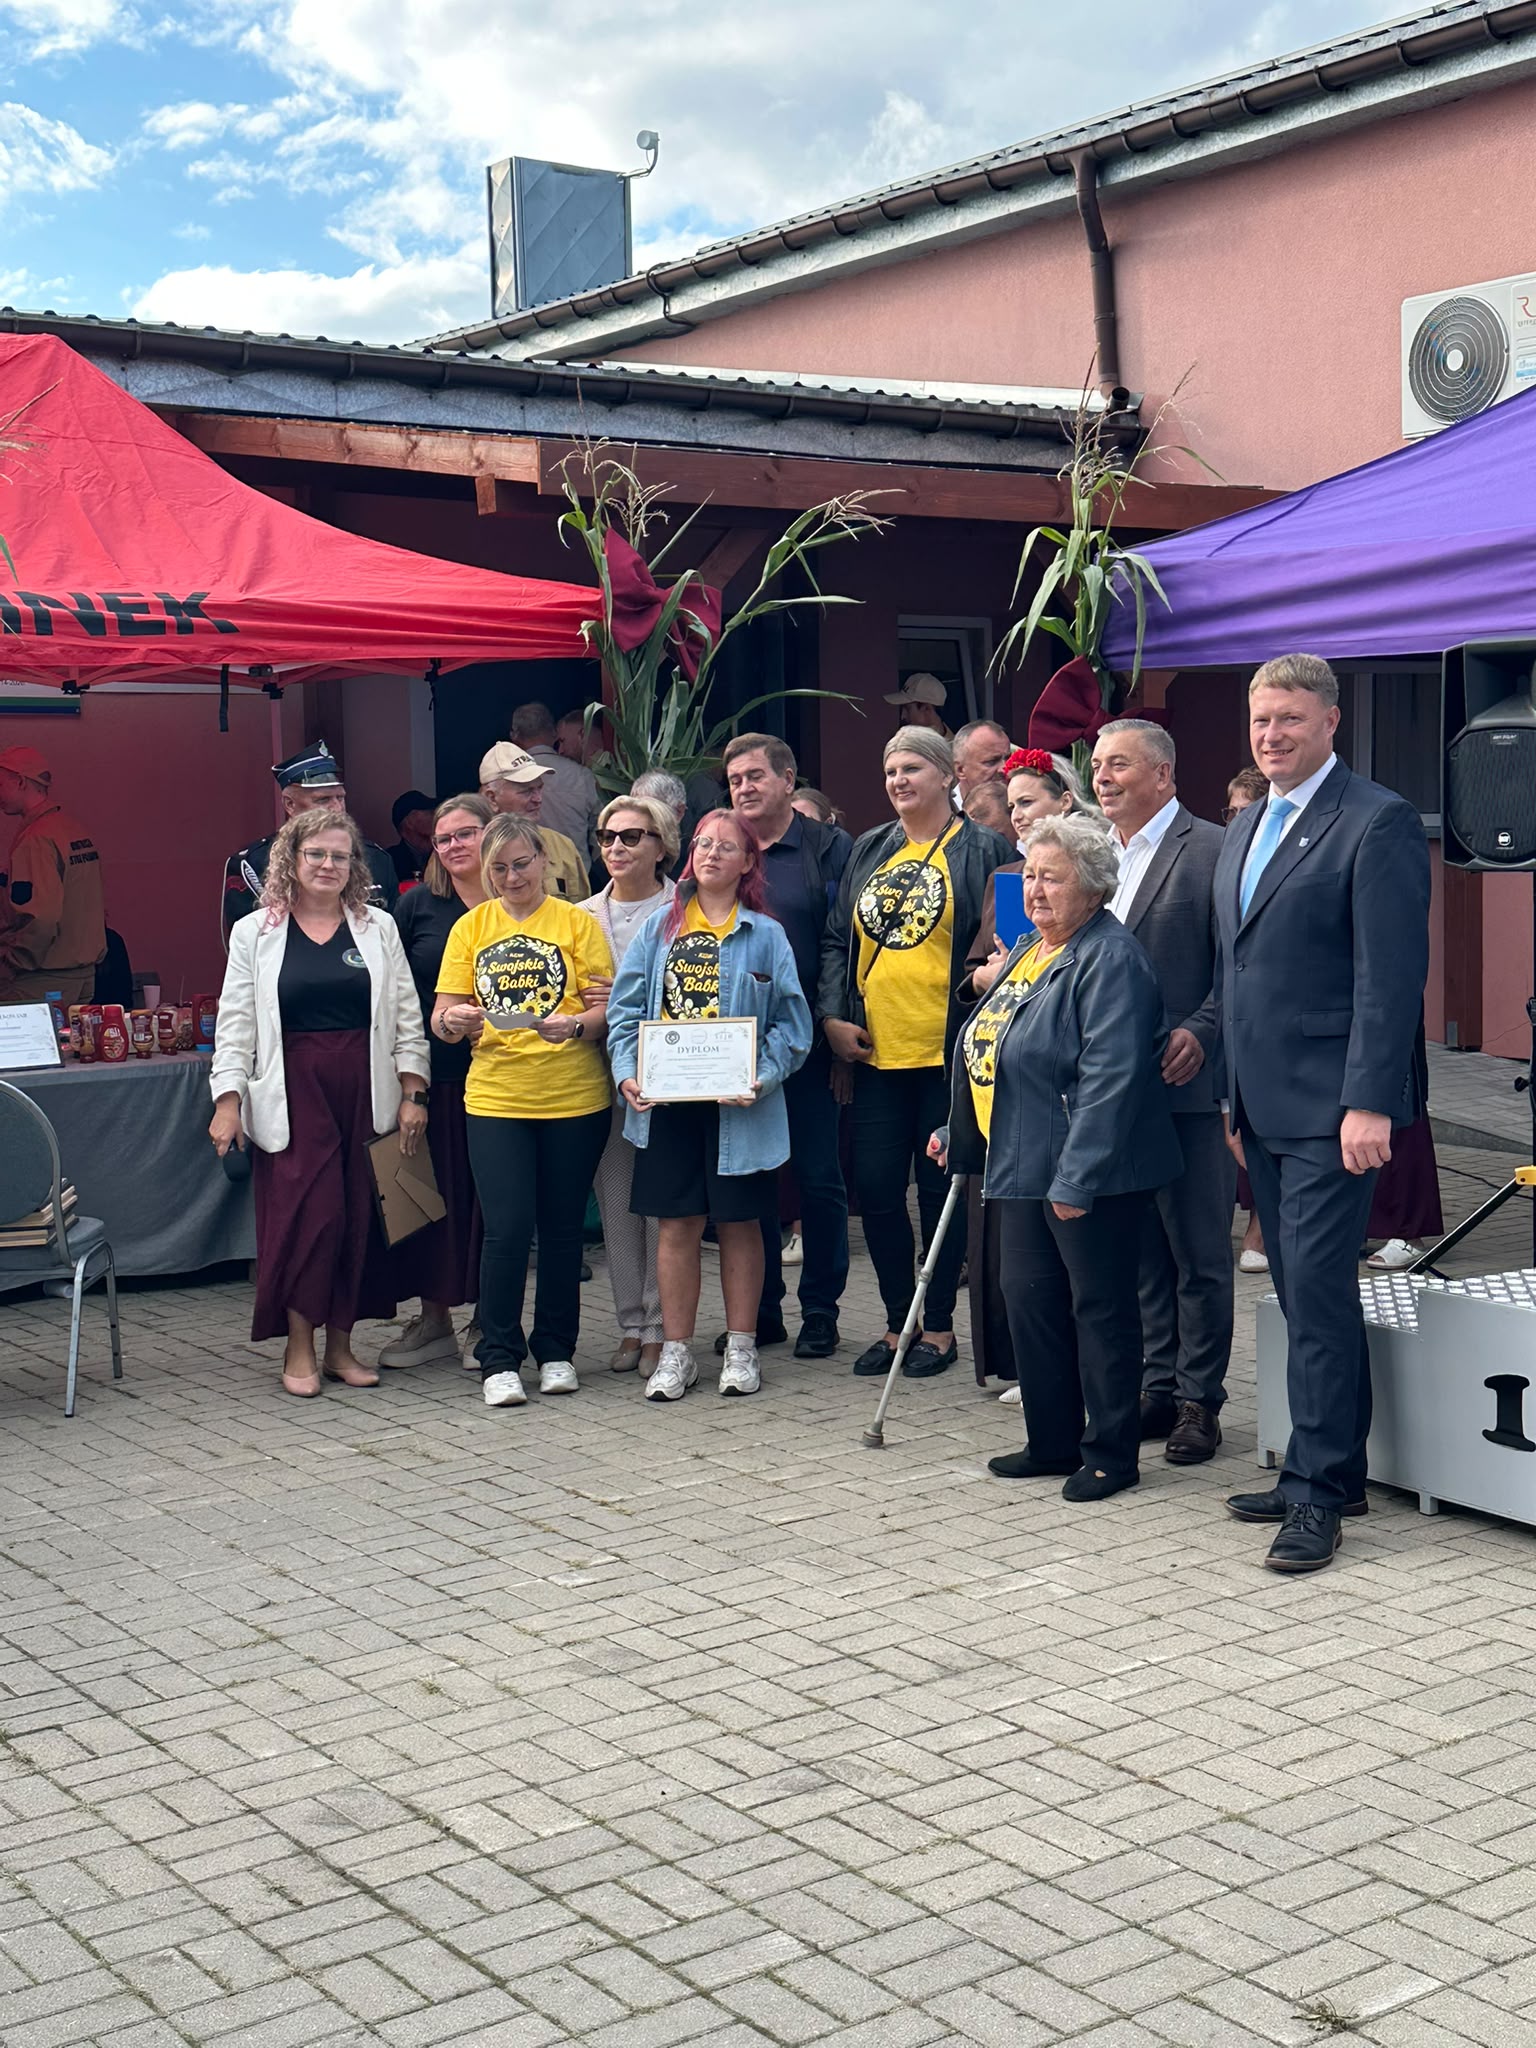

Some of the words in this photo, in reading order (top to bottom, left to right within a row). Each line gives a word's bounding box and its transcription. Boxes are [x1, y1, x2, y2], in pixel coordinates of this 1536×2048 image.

[488, 958, 545, 975] Swojskie
[674, 959, 720, 978] Swojsk
[497, 974, 540, 991] Babki
[683, 976, 719, 994] Babk
[677, 1045, 720, 1054] DYPLOM
